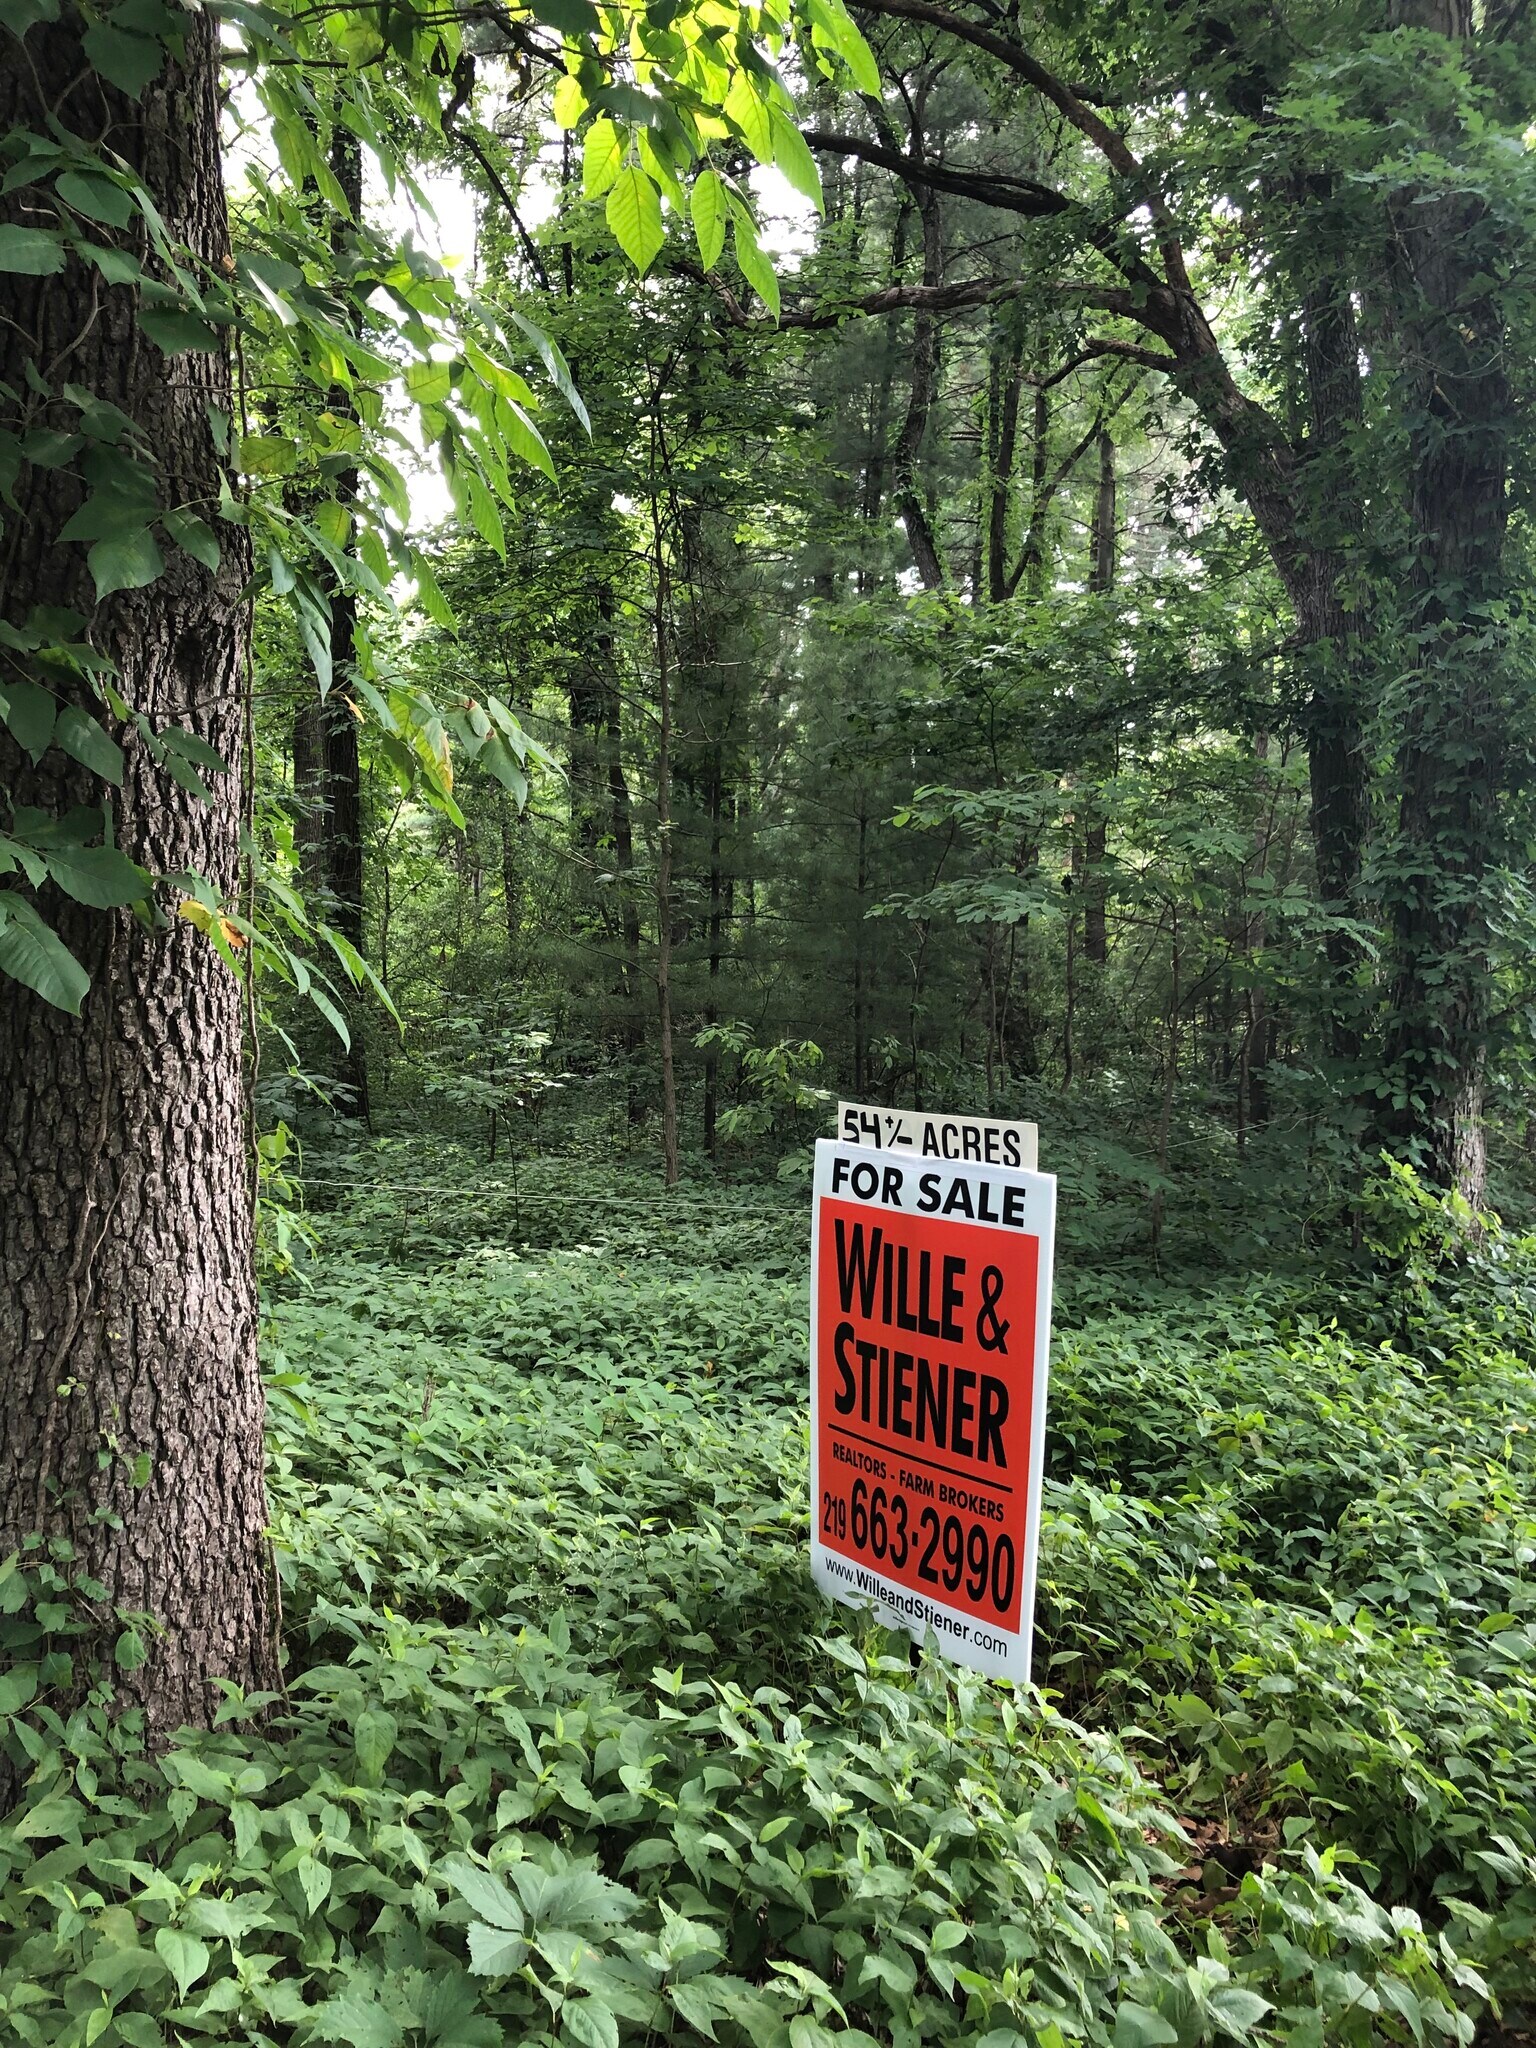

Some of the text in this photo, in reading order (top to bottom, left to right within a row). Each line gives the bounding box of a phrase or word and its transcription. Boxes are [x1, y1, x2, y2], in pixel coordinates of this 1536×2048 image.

[922, 1122, 1021, 1168] ACRES
[832, 1157, 1026, 1228] FOR SALE
[834, 1218, 1011, 1355] WILLE &
[834, 1321, 1009, 1469] STIENER
[823, 1491, 847, 1541] 219
[833, 1441, 887, 1480] REALTORS
[899, 1469, 935, 1499] FARM
[938, 1483, 1004, 1523] BROKERS
[825, 1556, 1008, 1658] www.WilleandStiener.com
